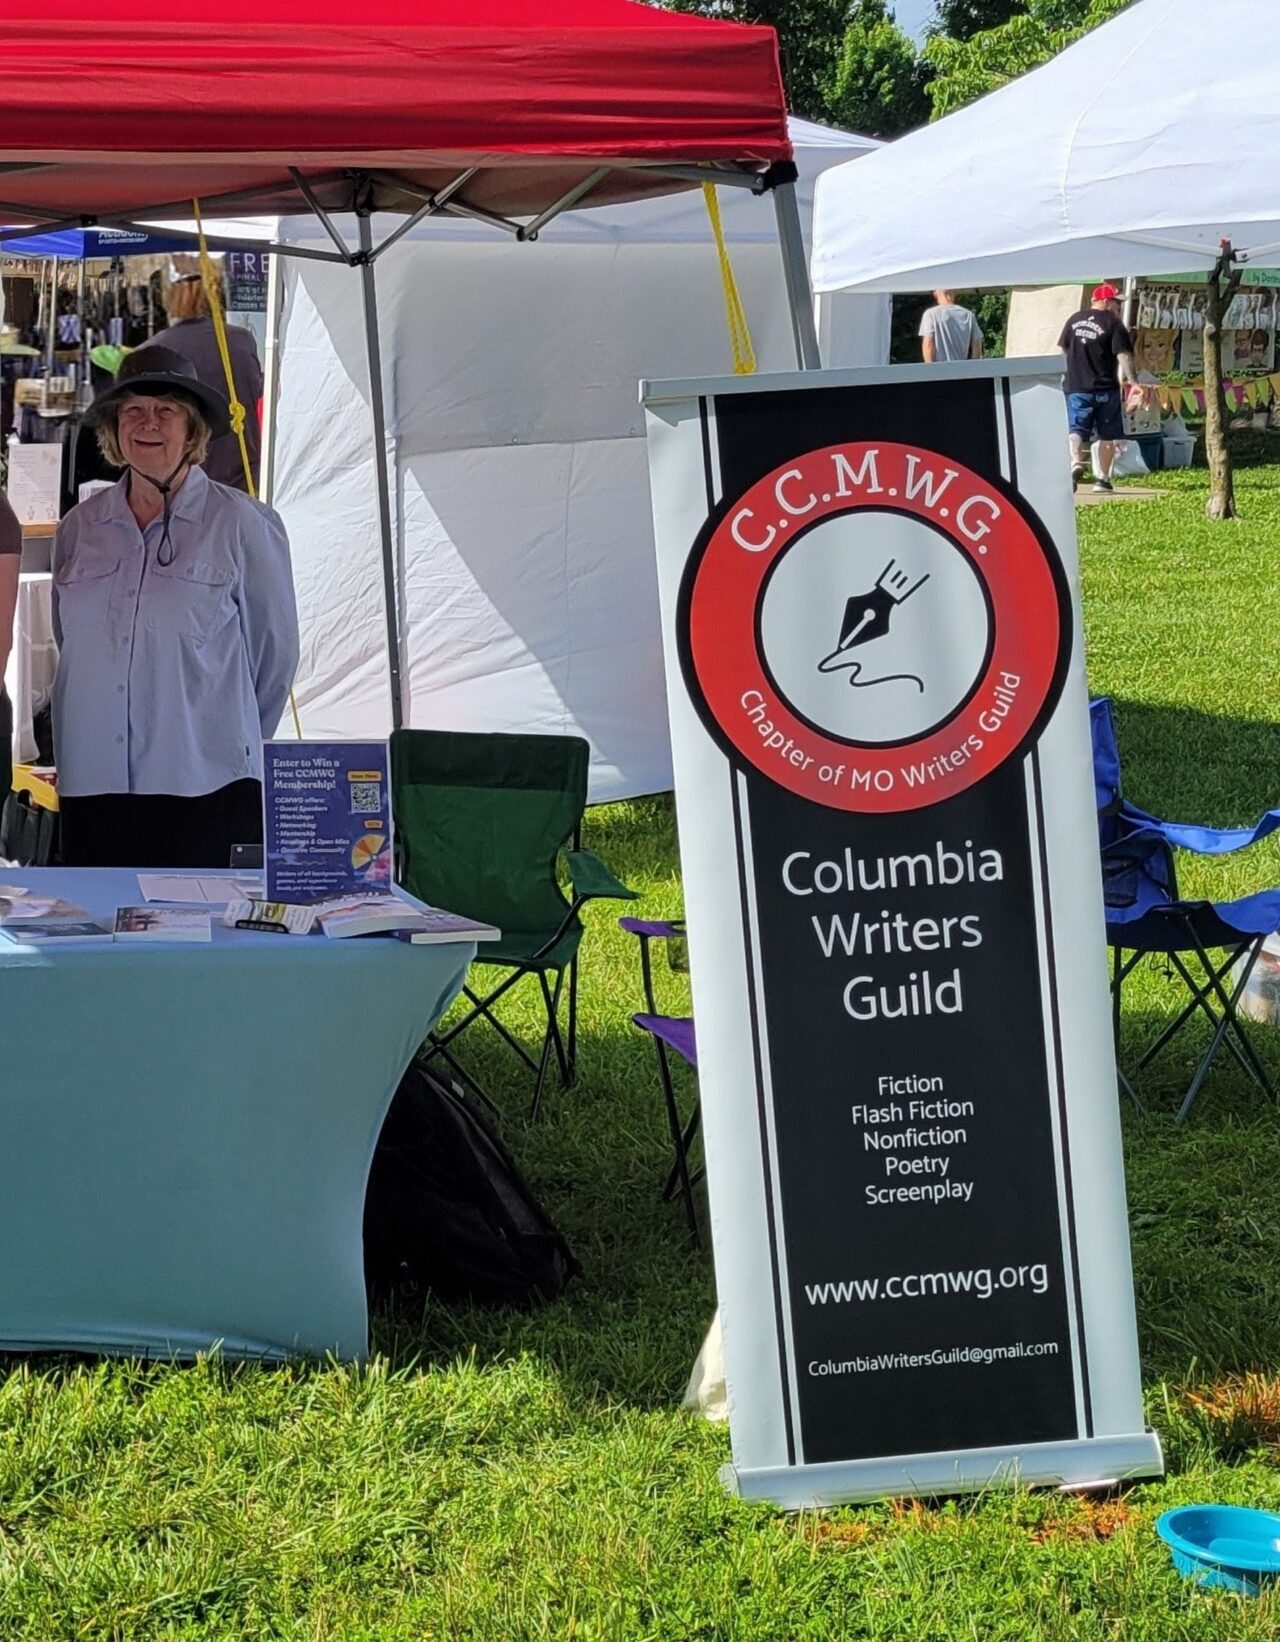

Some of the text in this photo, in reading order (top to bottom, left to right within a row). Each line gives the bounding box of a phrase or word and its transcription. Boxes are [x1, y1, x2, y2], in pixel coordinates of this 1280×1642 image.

[98, 231, 148, 242] Acad
[230, 253, 269, 273] FRE
[731, 450, 1001, 554] C.C.M.W.G.
[740, 671, 1021, 792] Chapter of MO Writers Guild
[273, 758, 300, 768] Enter
[301, 760, 311, 768] to
[312, 758, 332, 767] Win
[273, 769, 336, 778] Free CCMWG
[273, 780, 336, 790] Membership!
[280, 822, 317, 830] Networking
[782, 840, 1004, 896] Columbia
[811, 910, 983, 957] Writers
[843, 968, 963, 1020] Guild
[878, 1074, 943, 1096] Fiction
[851, 1098, 974, 1125] Flash Fiction
[863, 1126, 967, 1151] Nonfiction
[885, 1155, 950, 1176] Poetry
[865, 1179, 974, 1204] Screenplay
[805, 1263, 1048, 1305] www.ccmwg.org
[808, 1341, 1058, 1376] ColumbiaWritersGuild@gmail.com
